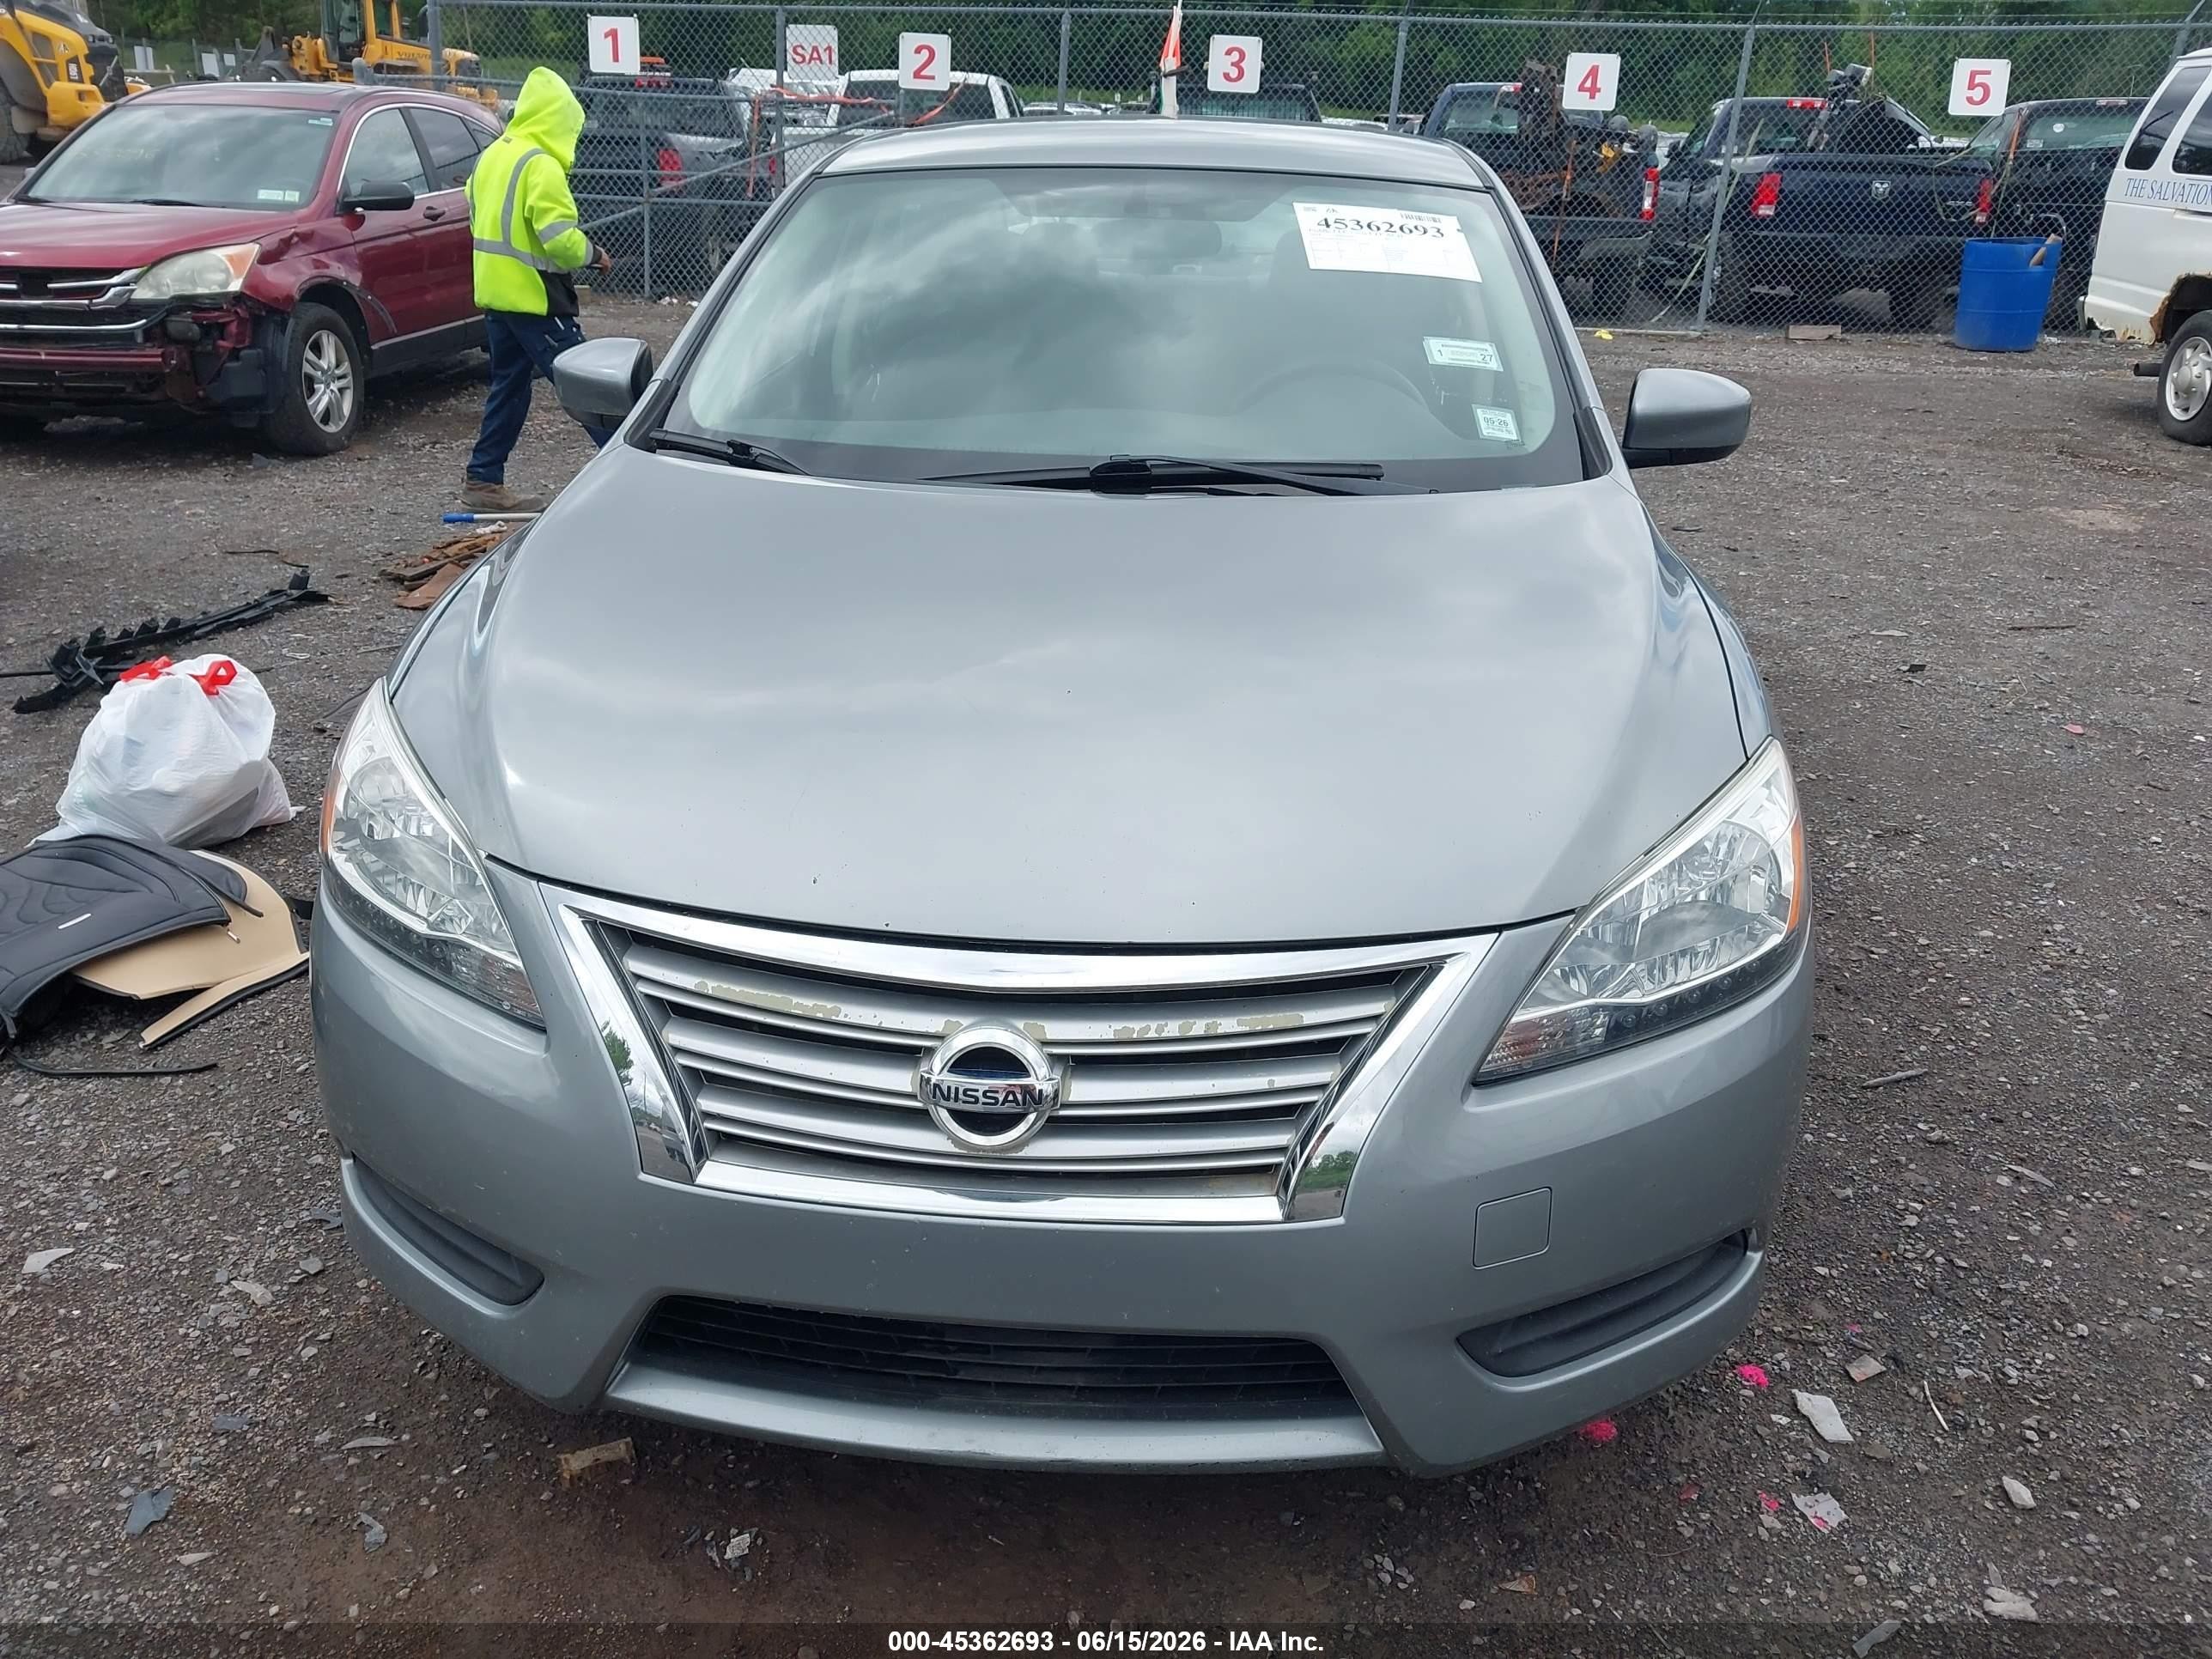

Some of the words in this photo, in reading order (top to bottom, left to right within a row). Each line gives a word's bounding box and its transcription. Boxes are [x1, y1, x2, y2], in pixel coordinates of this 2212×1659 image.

[604, 27, 619, 63] 1
[792, 45, 834, 65] SA1
[913, 45, 936, 81] 2
[1223, 46, 1246, 83] 3
[1577, 64, 1601, 100] 4
[1966, 70, 1992, 106] 5
[2124, 178, 2148, 198] THE
[1316, 217, 1444, 238] 45362693
[932, 1083, 1043, 1106] NISSAN
